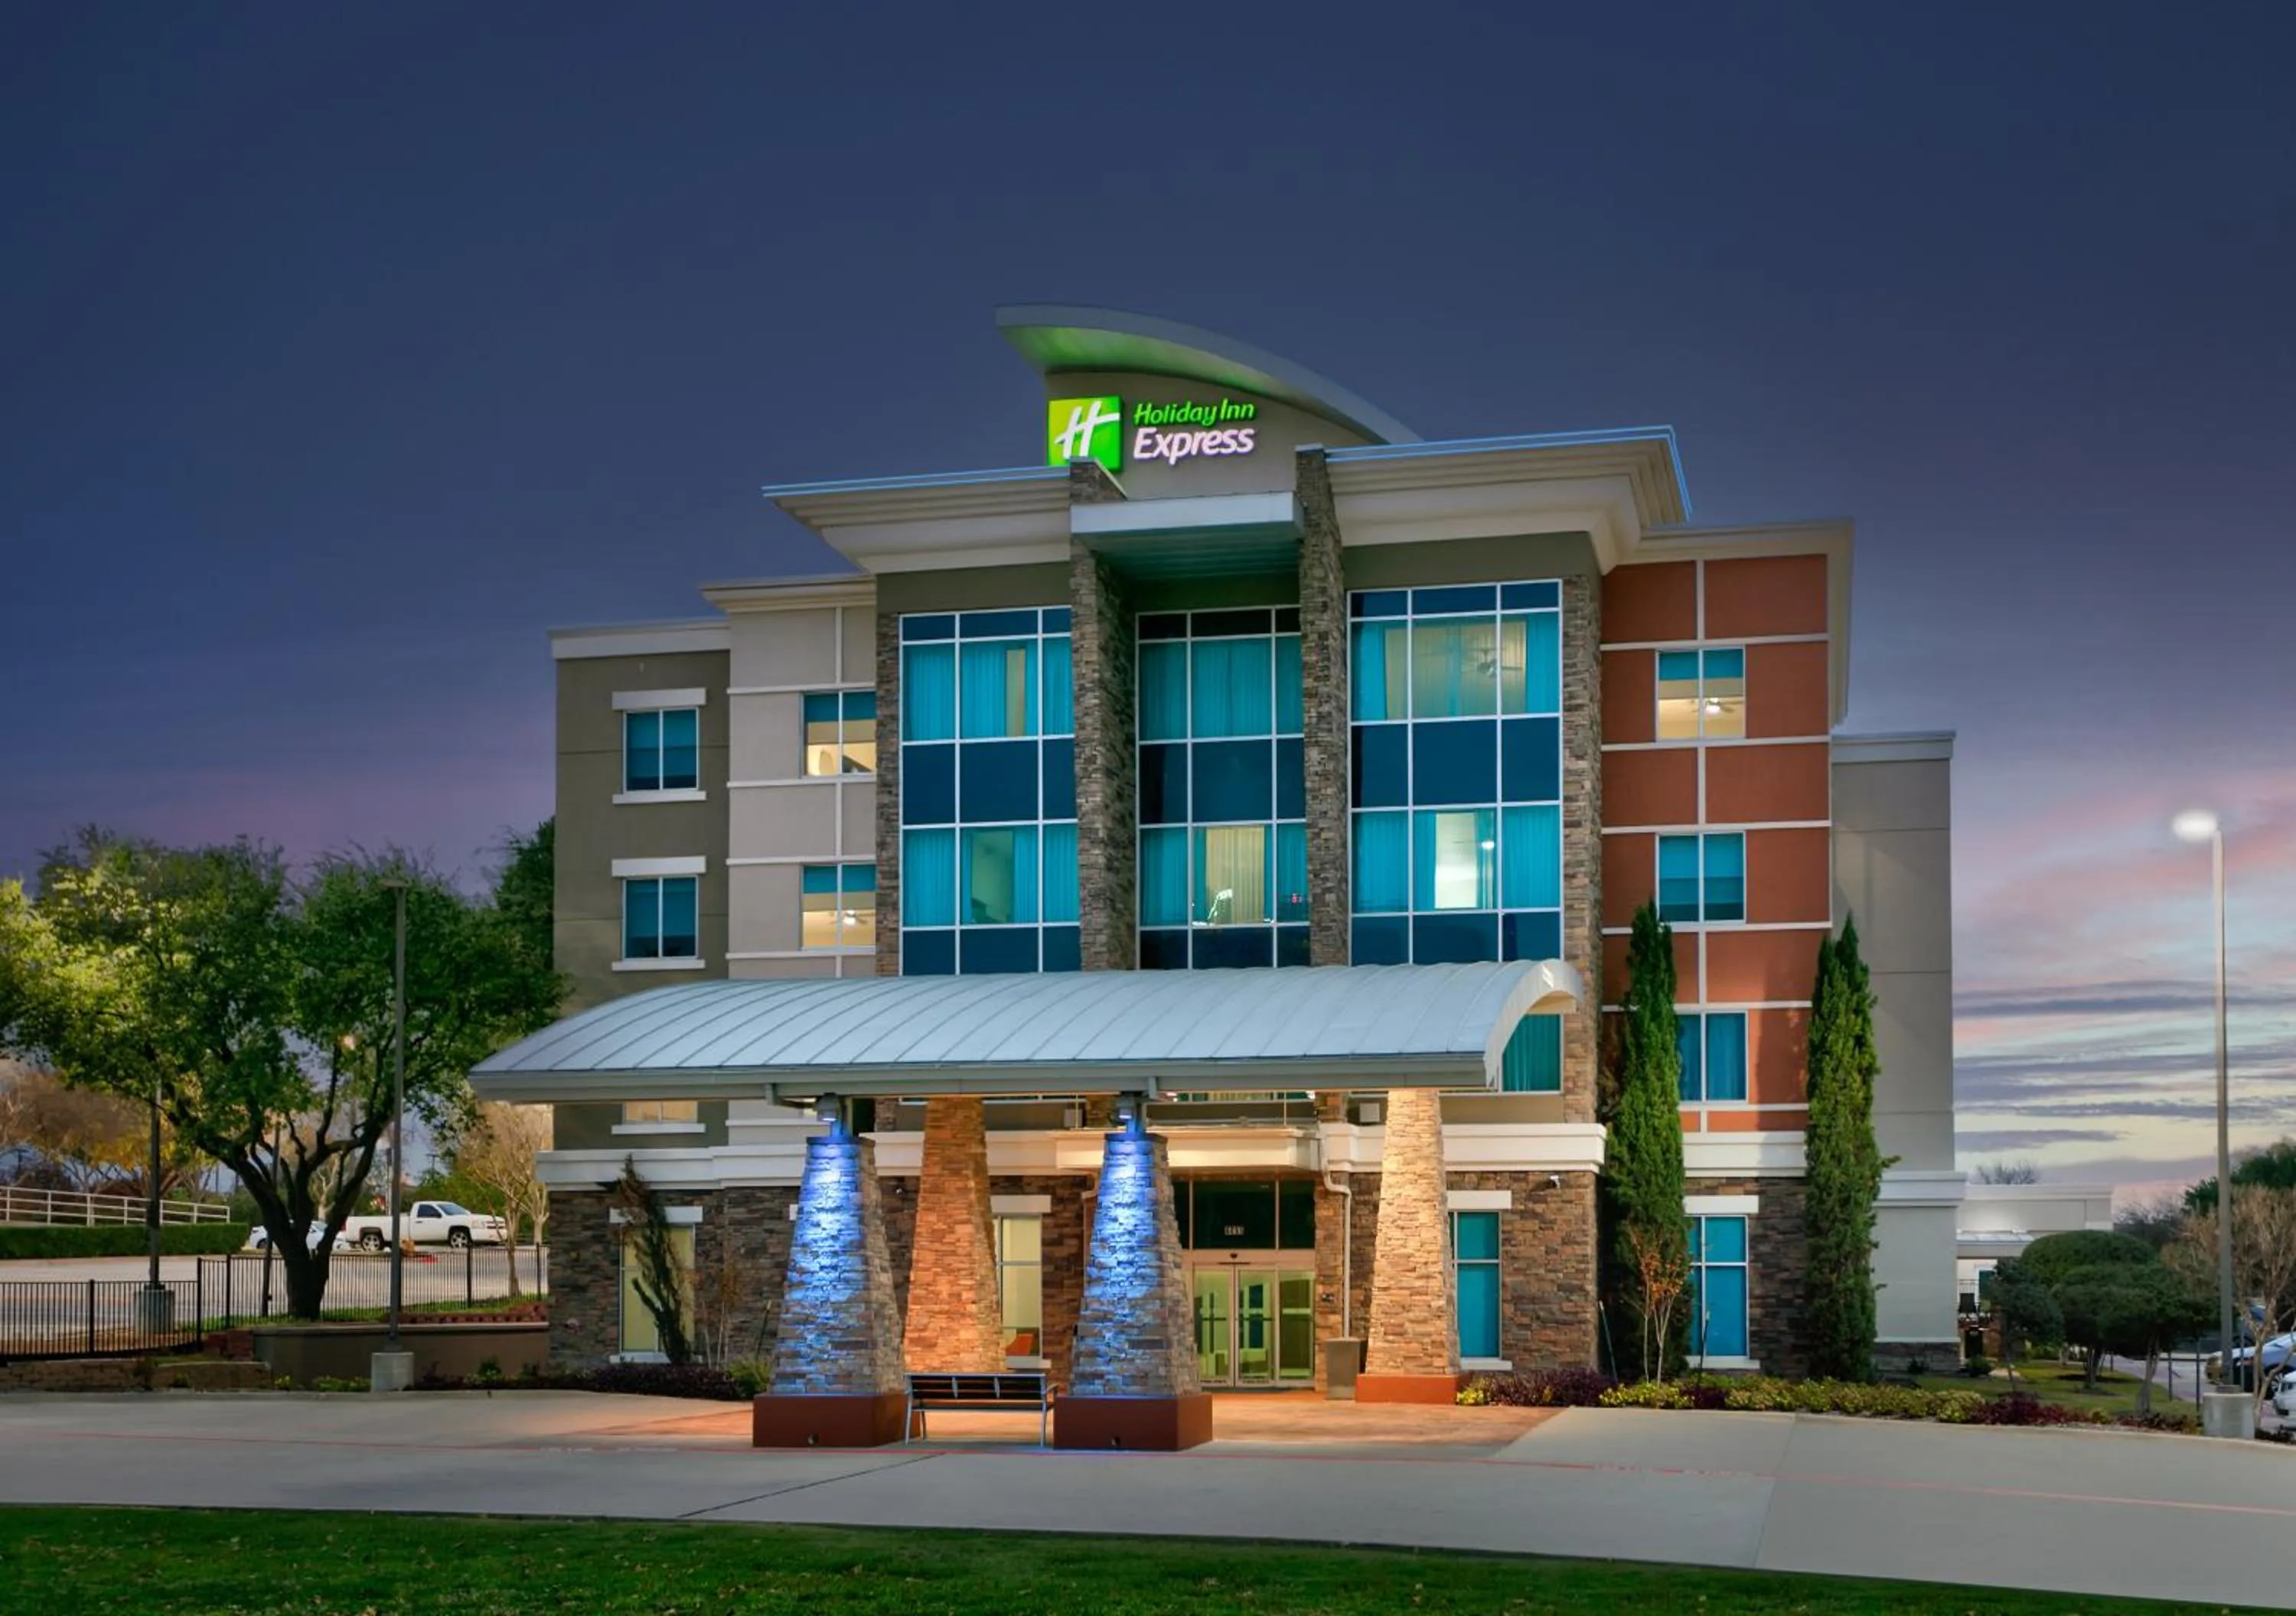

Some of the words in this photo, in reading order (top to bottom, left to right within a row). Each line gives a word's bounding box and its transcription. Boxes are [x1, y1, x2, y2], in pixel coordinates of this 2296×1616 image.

[1133, 401, 1216, 425] Holiday
[1220, 399, 1255, 419] Inn
[1133, 427, 1255, 465] Express
